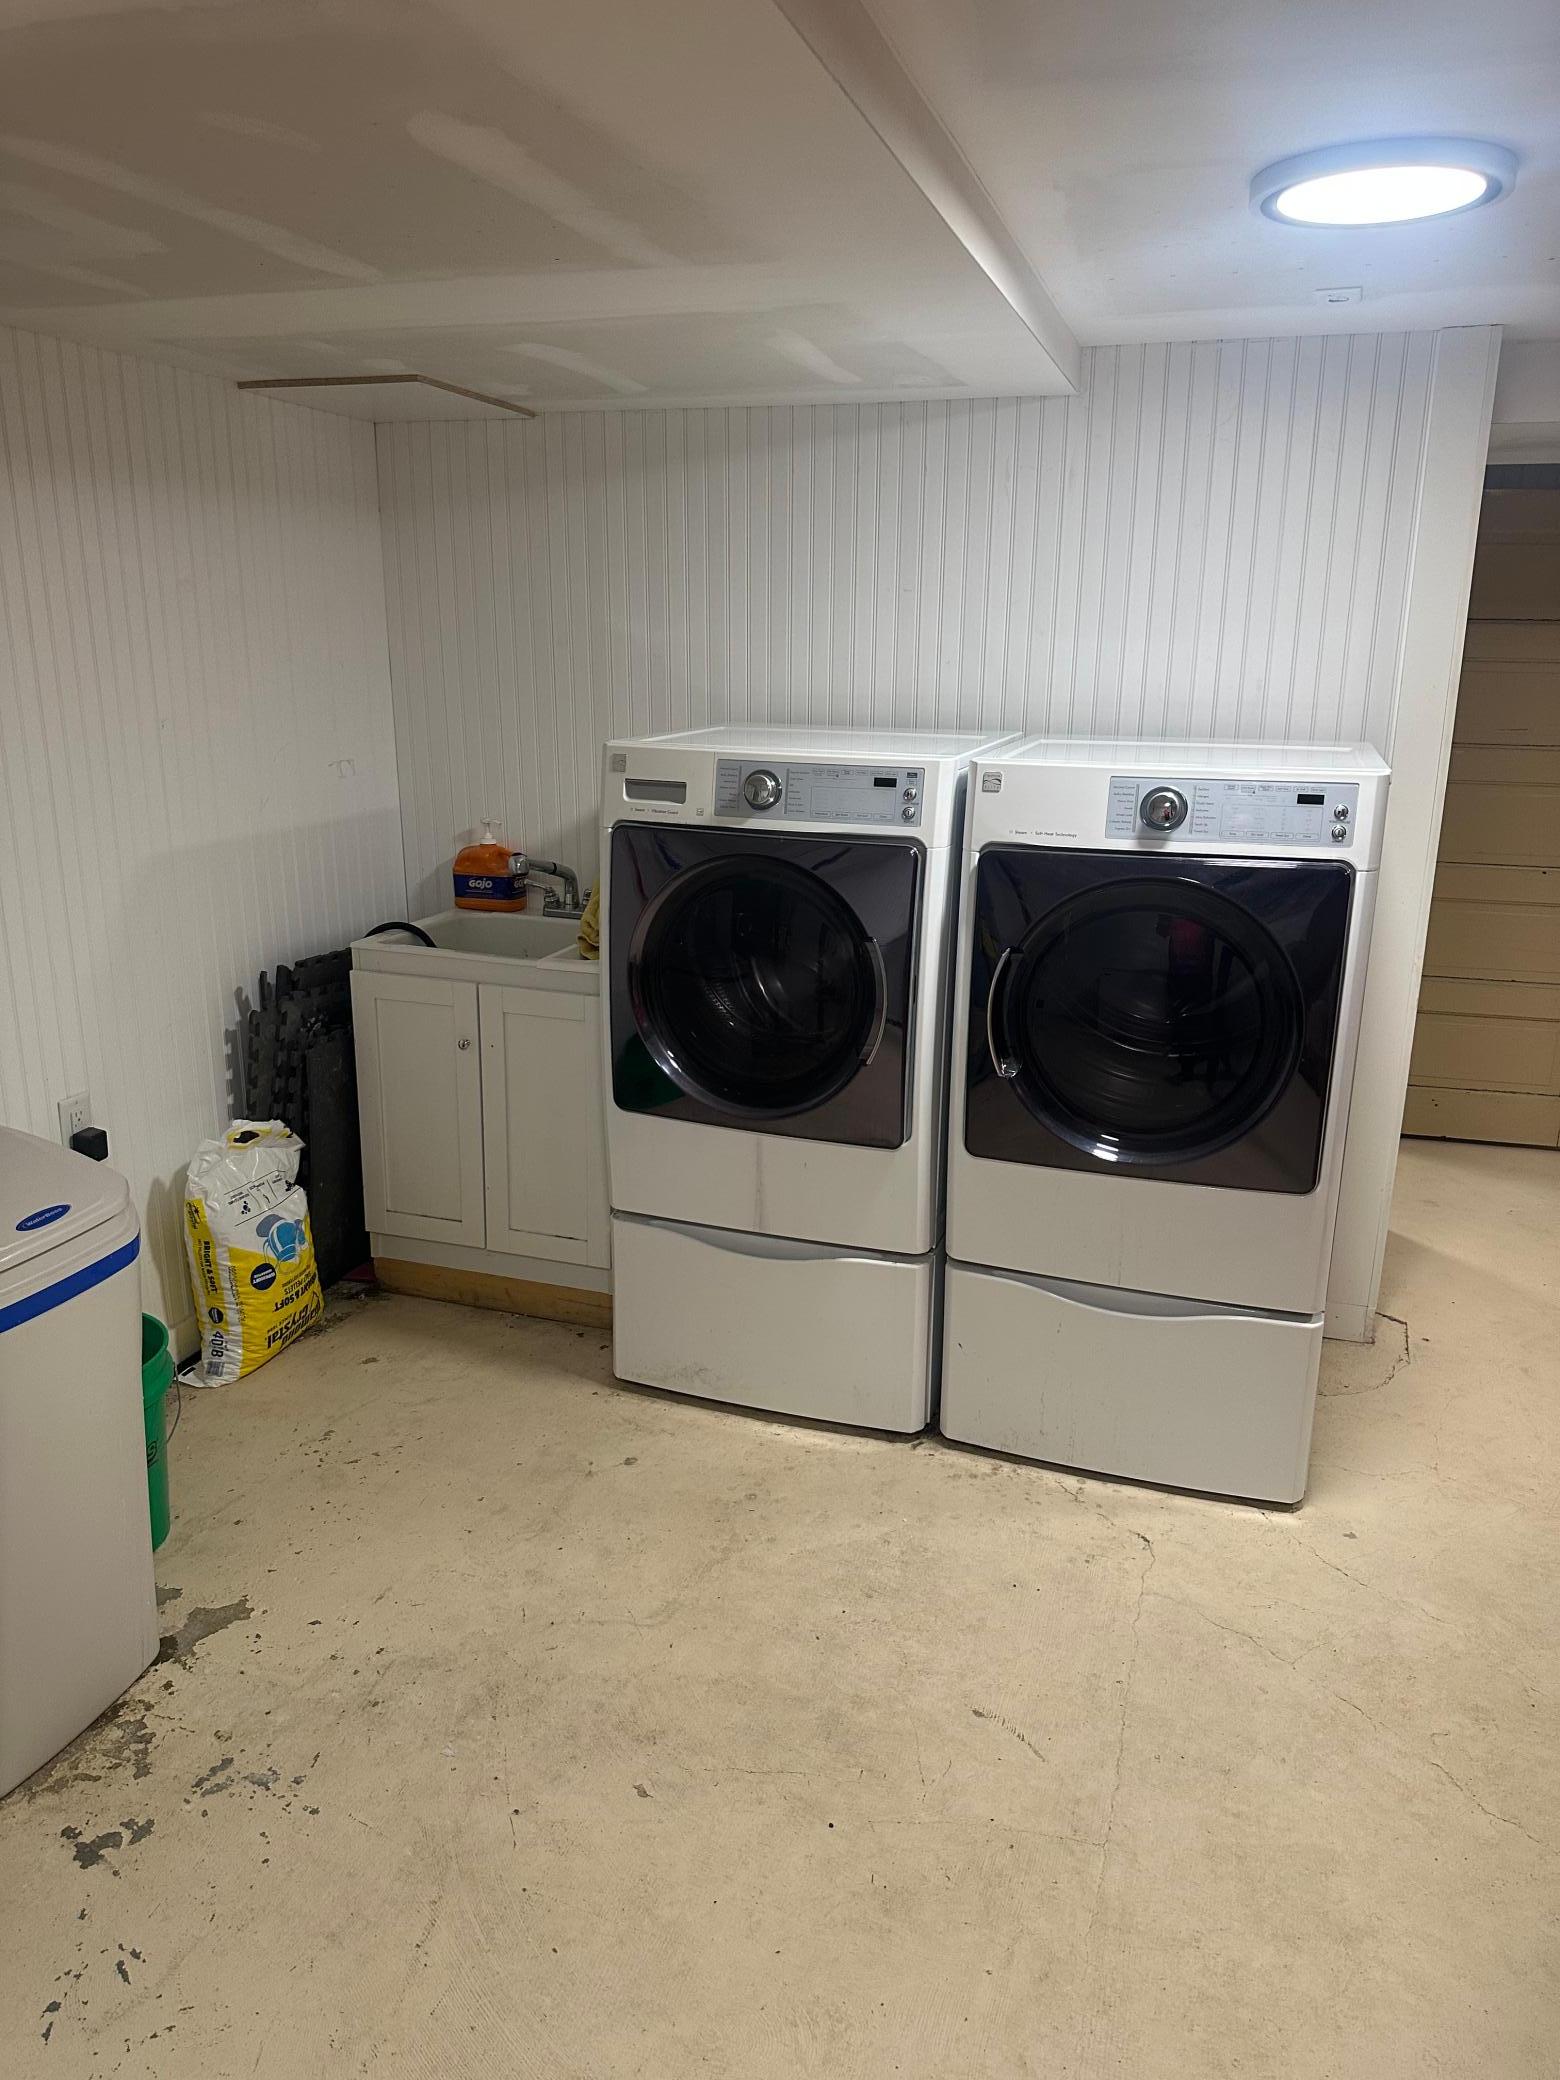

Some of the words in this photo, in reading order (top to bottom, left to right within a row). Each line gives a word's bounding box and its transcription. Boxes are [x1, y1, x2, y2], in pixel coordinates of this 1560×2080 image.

[468, 878, 493, 890] GOJO
[203, 1240, 212, 1268] BRIGHT
[206, 1268, 213, 1276] &
[207, 1275, 218, 1295] SOFT
[273, 1295, 296, 1312] SOFT
[267, 1303, 310, 1349] Crystal
